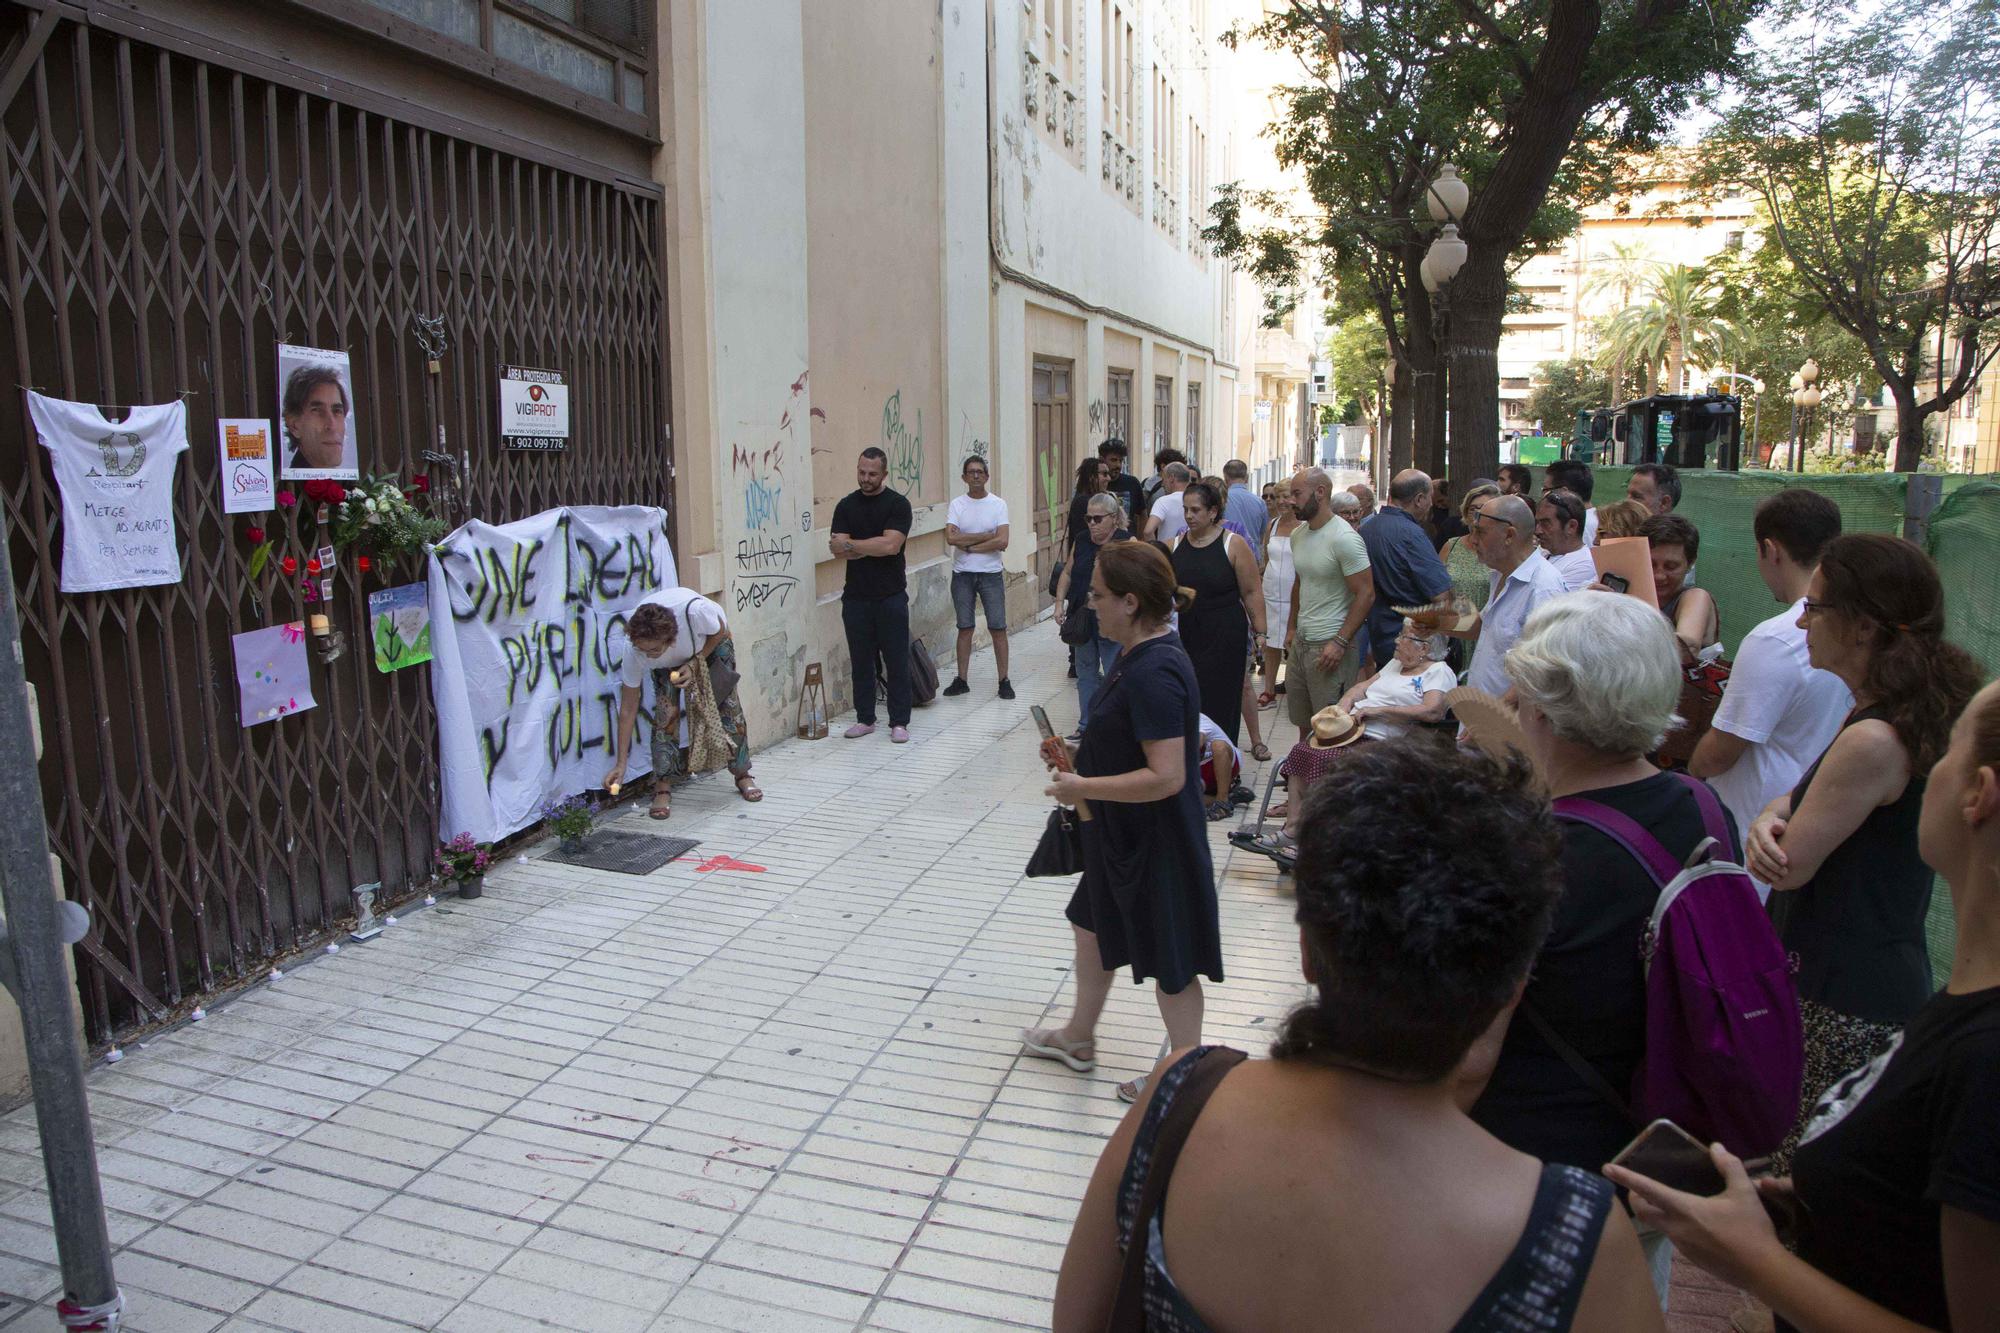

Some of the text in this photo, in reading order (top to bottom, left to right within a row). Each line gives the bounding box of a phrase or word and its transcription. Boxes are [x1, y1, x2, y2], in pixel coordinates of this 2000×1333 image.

[507, 365, 522, 380] ÁREA
[523, 369, 551, 383] PROTEGIDA
[515, 402, 557, 417] VIGIPROT
[507, 428, 564, 436] www.vigiprot.com
[508, 437, 564, 449] T. 902 099 778
[98, 542, 160, 558] PER SEMPRE
[482, 716, 510, 800] Y
